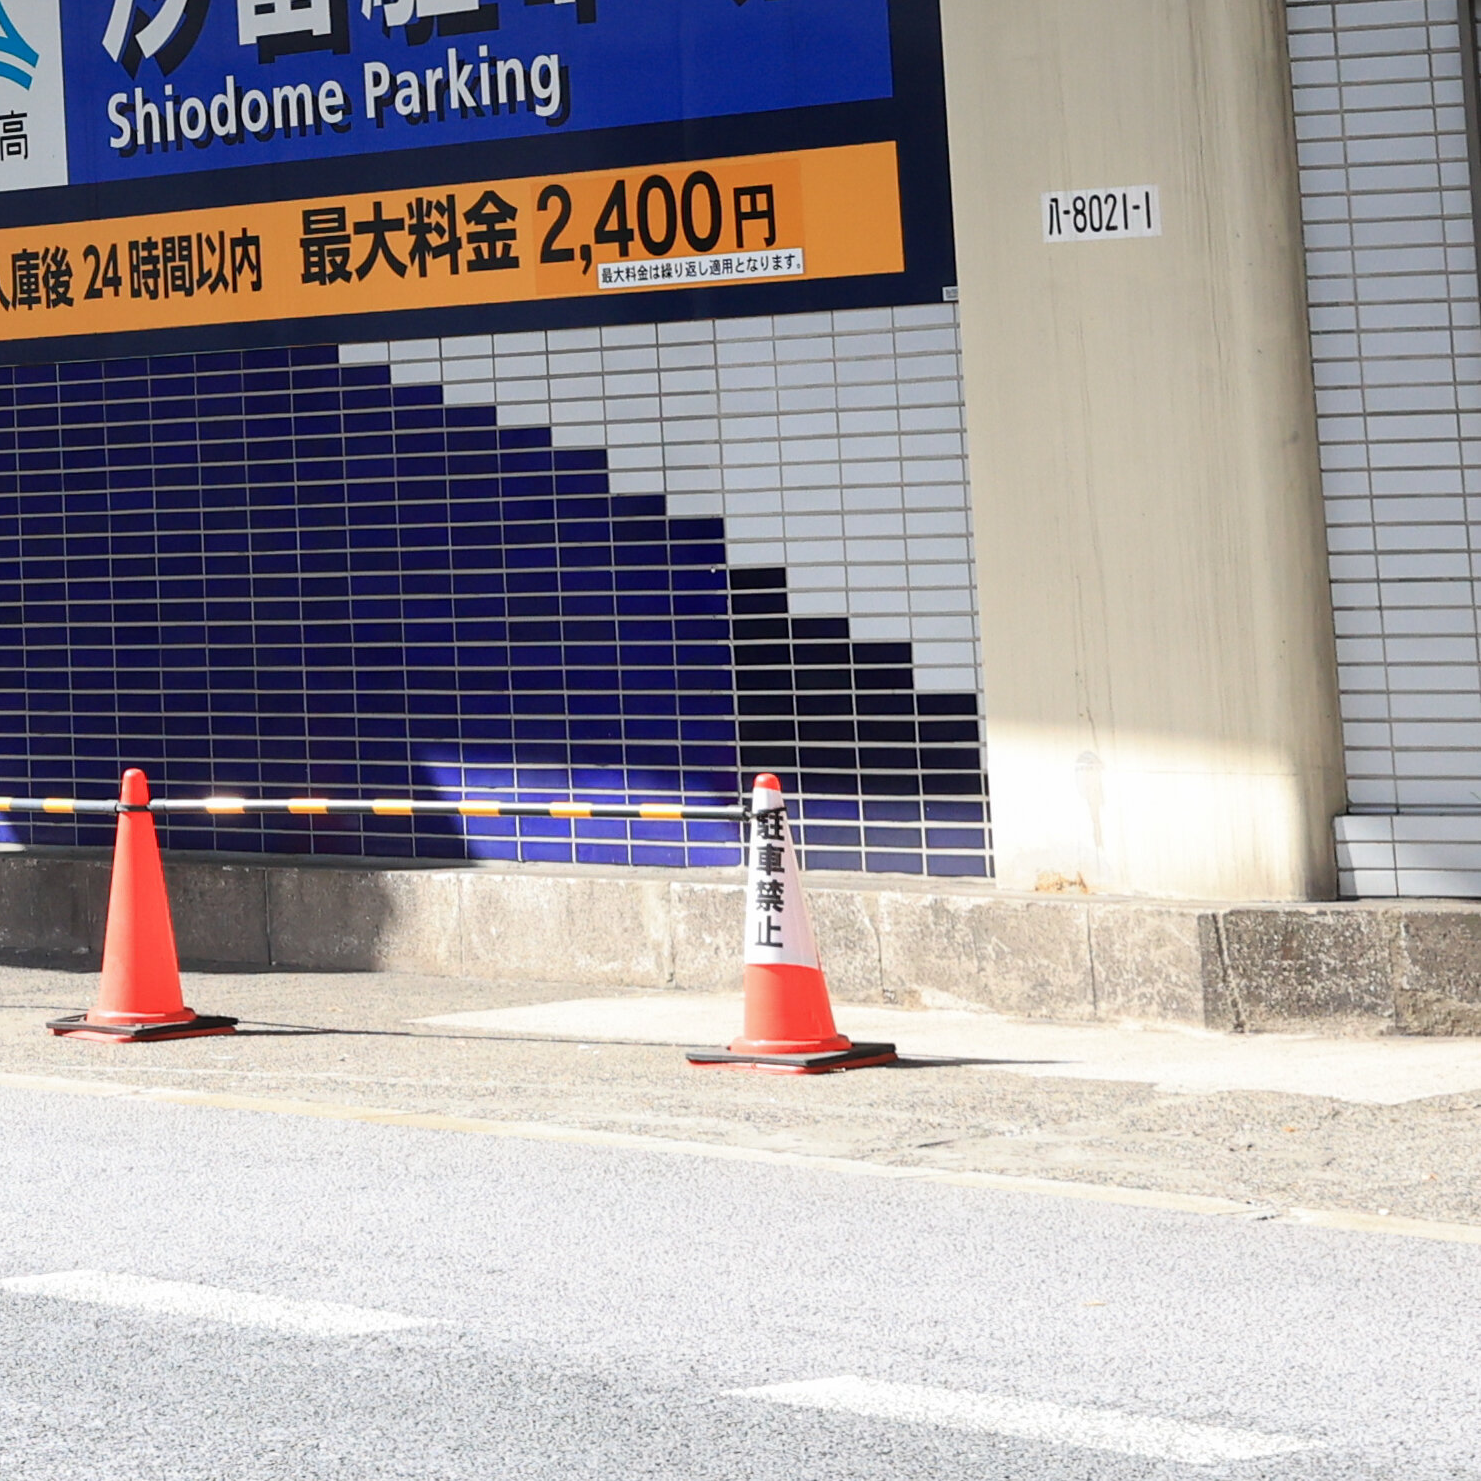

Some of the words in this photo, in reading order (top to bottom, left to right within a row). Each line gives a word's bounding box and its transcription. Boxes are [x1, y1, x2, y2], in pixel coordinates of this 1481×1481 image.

[106, 75, 344, 149] Shiodome
[364, 45, 562, 118] Parking
[601, 253, 802, 284] 最大料金は繰り返し適用となります。
[755, 809, 785, 949] 駐車禁止
